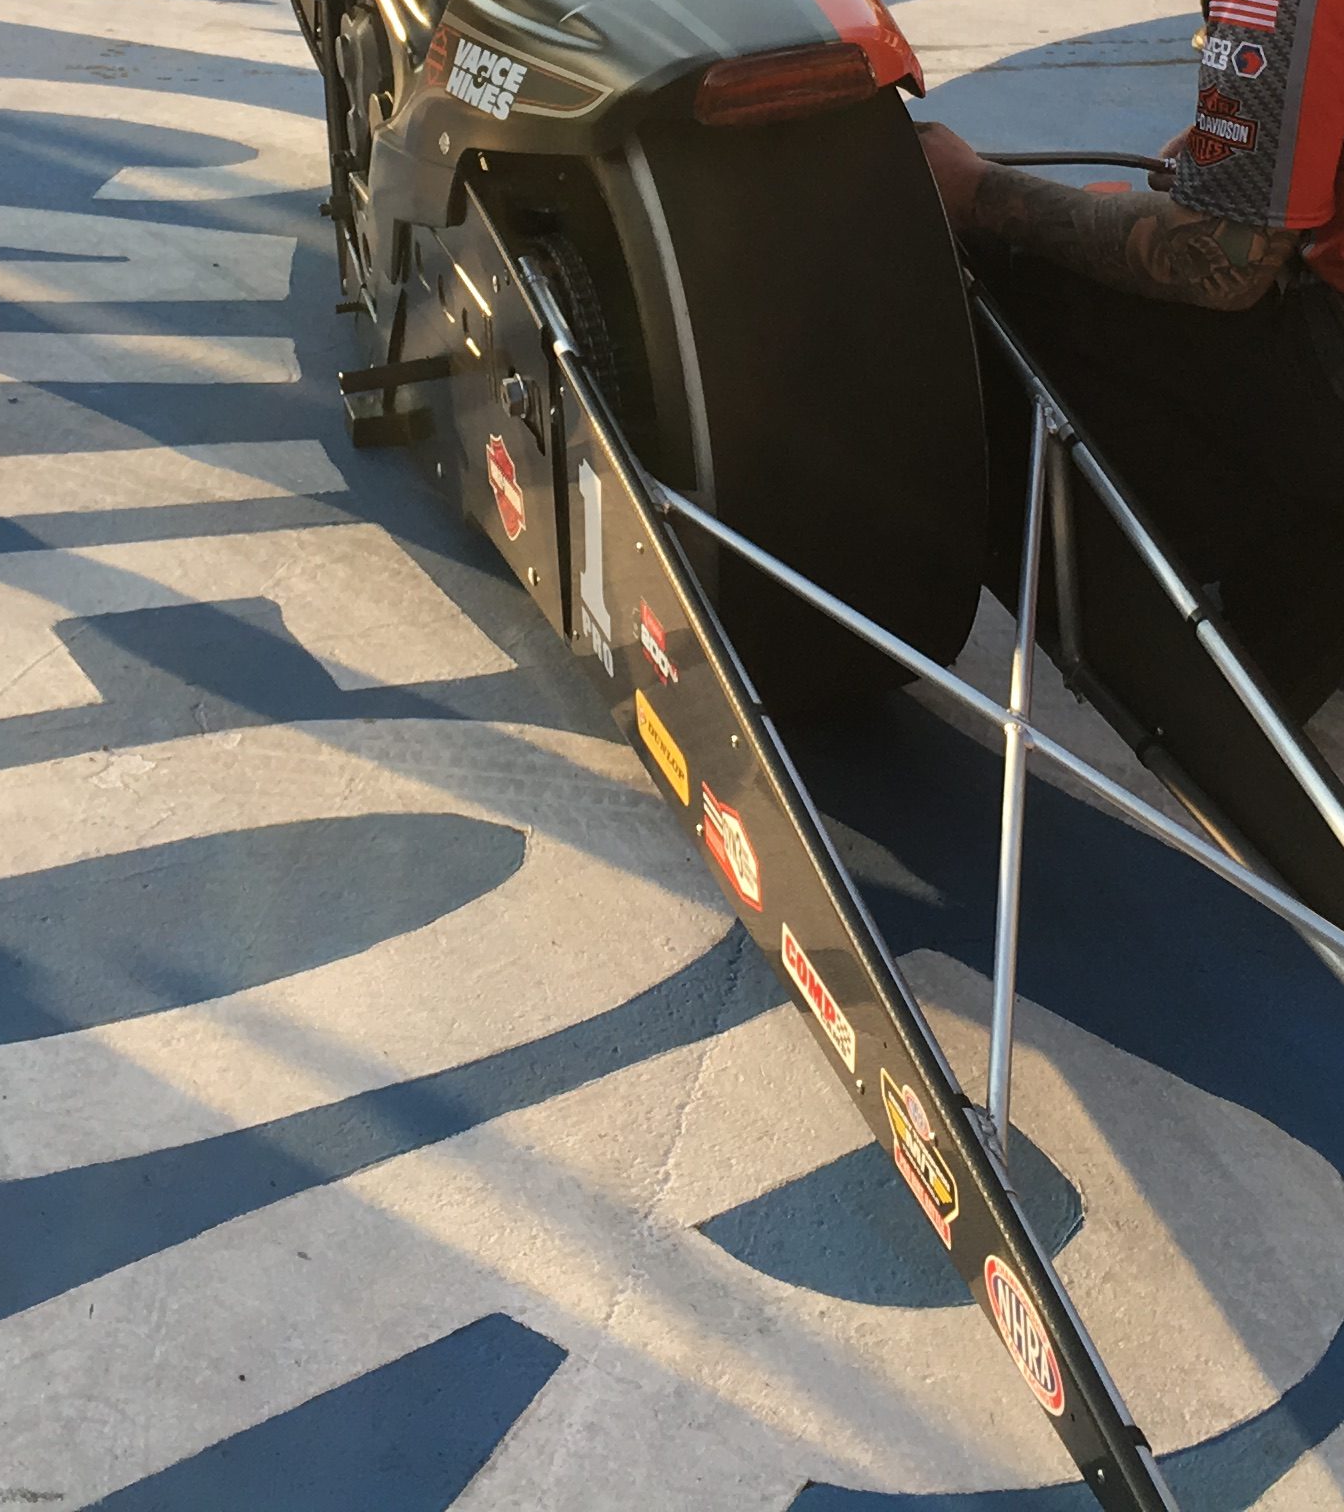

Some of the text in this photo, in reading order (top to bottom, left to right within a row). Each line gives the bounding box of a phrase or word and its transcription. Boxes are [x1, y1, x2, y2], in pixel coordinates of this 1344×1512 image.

[445, 66, 514, 121] HINES
[453, 38, 528, 94] VANCE
[581, 605, 615, 679] PRO
[646, 723, 685, 782] DUNLOP
[785, 934, 837, 1024] COMP
[997, 1277, 1053, 1391] NHRA
